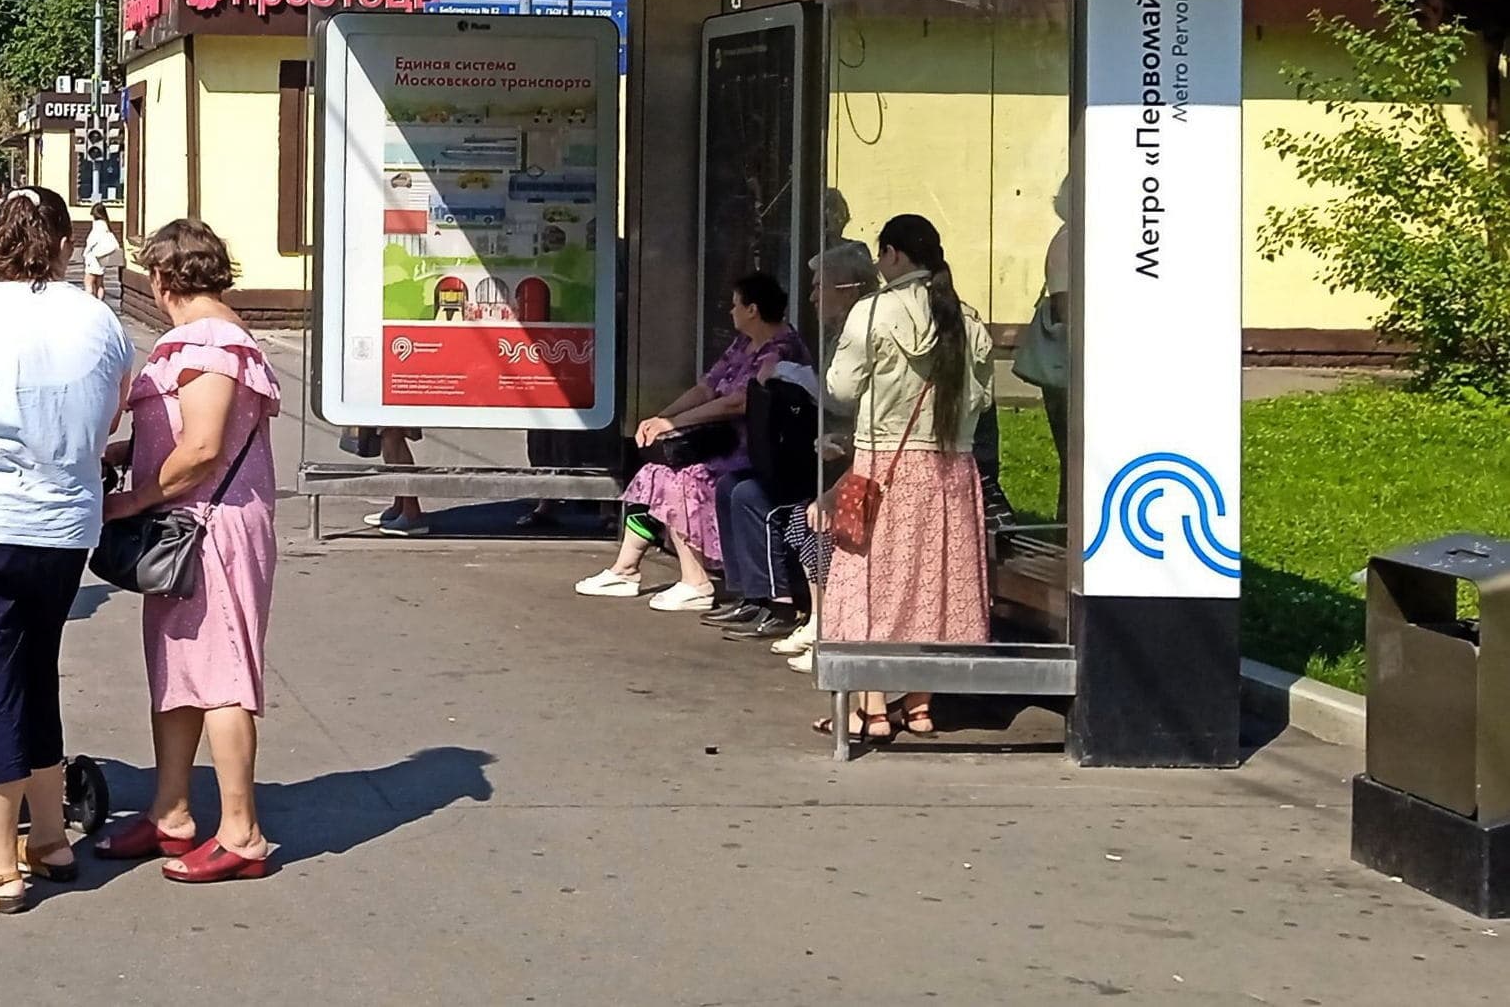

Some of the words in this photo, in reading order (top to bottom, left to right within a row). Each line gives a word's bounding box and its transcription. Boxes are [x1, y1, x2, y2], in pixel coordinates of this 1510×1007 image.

[395, 57, 451, 72] Единая
[455, 60, 516, 72] система
[395, 73, 497, 88] Московского
[501, 77, 592, 91] транспорта
[1172, 63, 1188, 123] Metro
[45, 102, 92, 117] COFFEE
[1136, 176, 1165, 279] Метро
